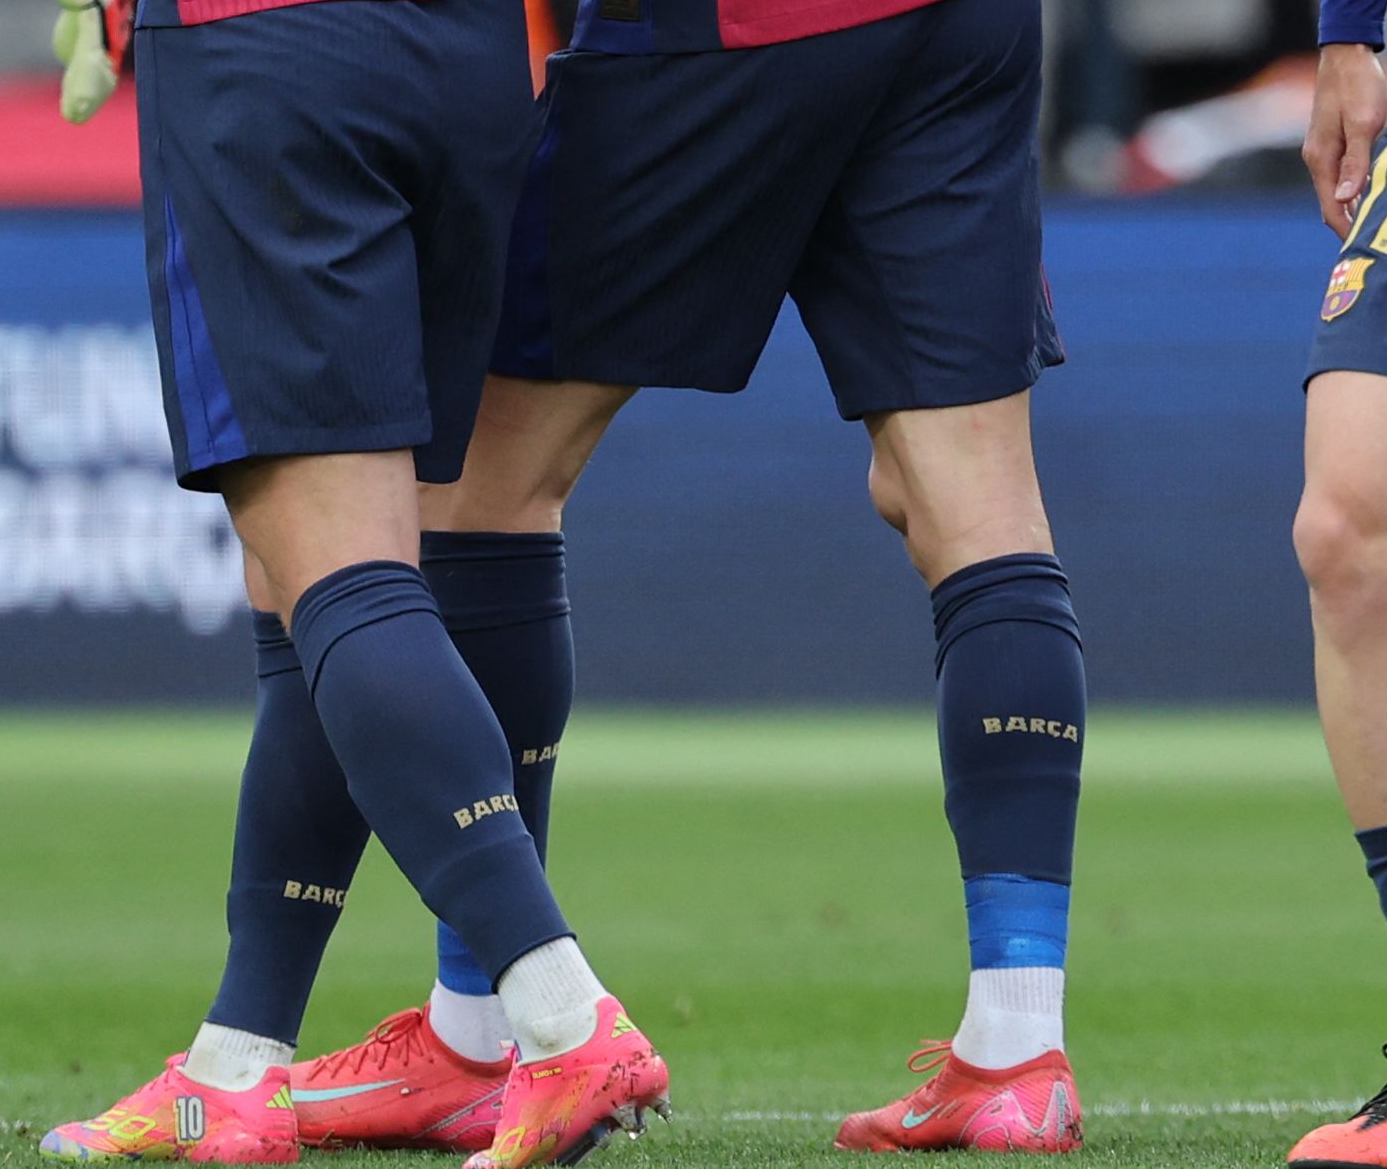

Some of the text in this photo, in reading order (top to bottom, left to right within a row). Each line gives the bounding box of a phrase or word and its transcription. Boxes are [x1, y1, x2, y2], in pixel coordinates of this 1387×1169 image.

[982, 716, 1078, 743] BARÇA
[453, 794, 519, 830] BARÇ
[283, 880, 349, 908] BARÇ
[176, 1095, 206, 1142] 10
